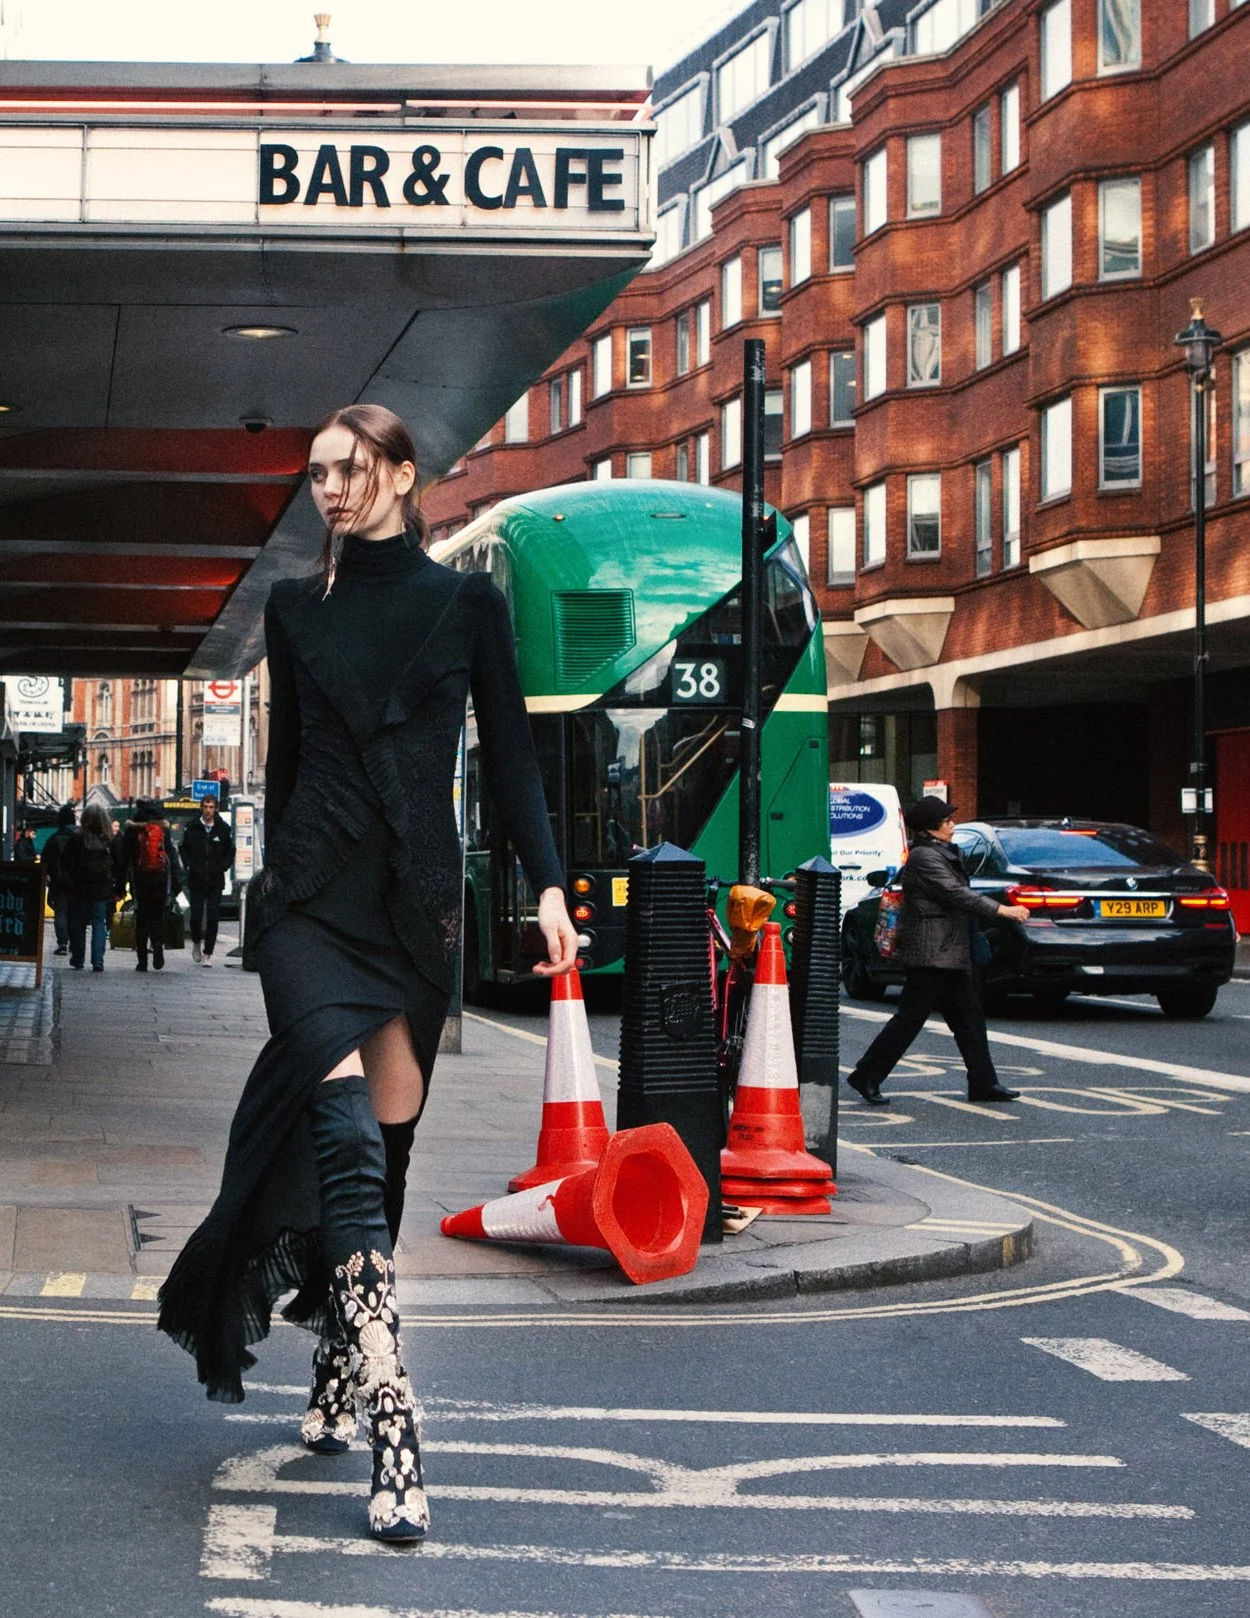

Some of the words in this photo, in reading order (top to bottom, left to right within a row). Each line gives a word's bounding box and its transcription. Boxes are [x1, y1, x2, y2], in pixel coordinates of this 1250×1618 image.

[258, 144, 391, 208] BAR
[403, 144, 451, 207] &
[464, 145, 625, 211] CAFE
[674, 662, 720, 698] 38
[830, 812, 864, 820] OLUTIONS
[1106, 902, 1131, 914] Y29
[1135, 902, 1159, 914] ARP
